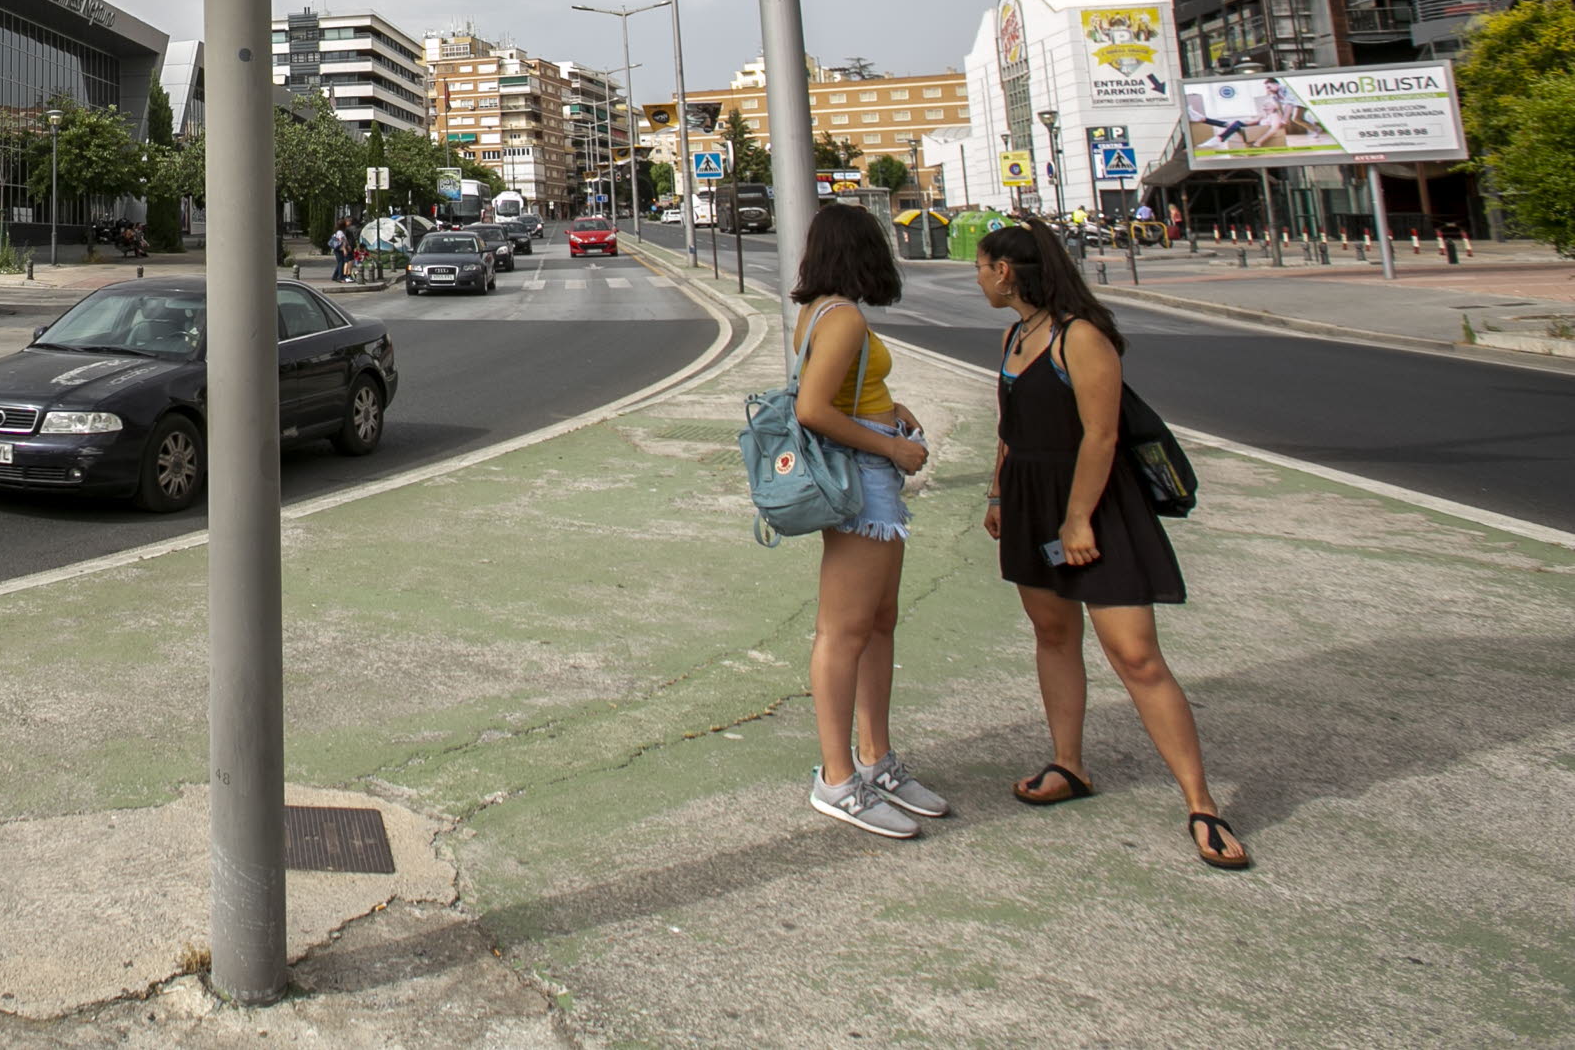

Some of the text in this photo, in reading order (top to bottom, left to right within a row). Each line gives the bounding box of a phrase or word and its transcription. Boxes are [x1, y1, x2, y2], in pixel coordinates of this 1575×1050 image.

[1094, 79, 1145, 88] ENTRADA
[1096, 87, 1146, 96] PARKING
[1405, 109, 1445, 117] GRANADA
[1112, 127, 1124, 138] P
[1358, 127, 1428, 138] 958 98 98 98
